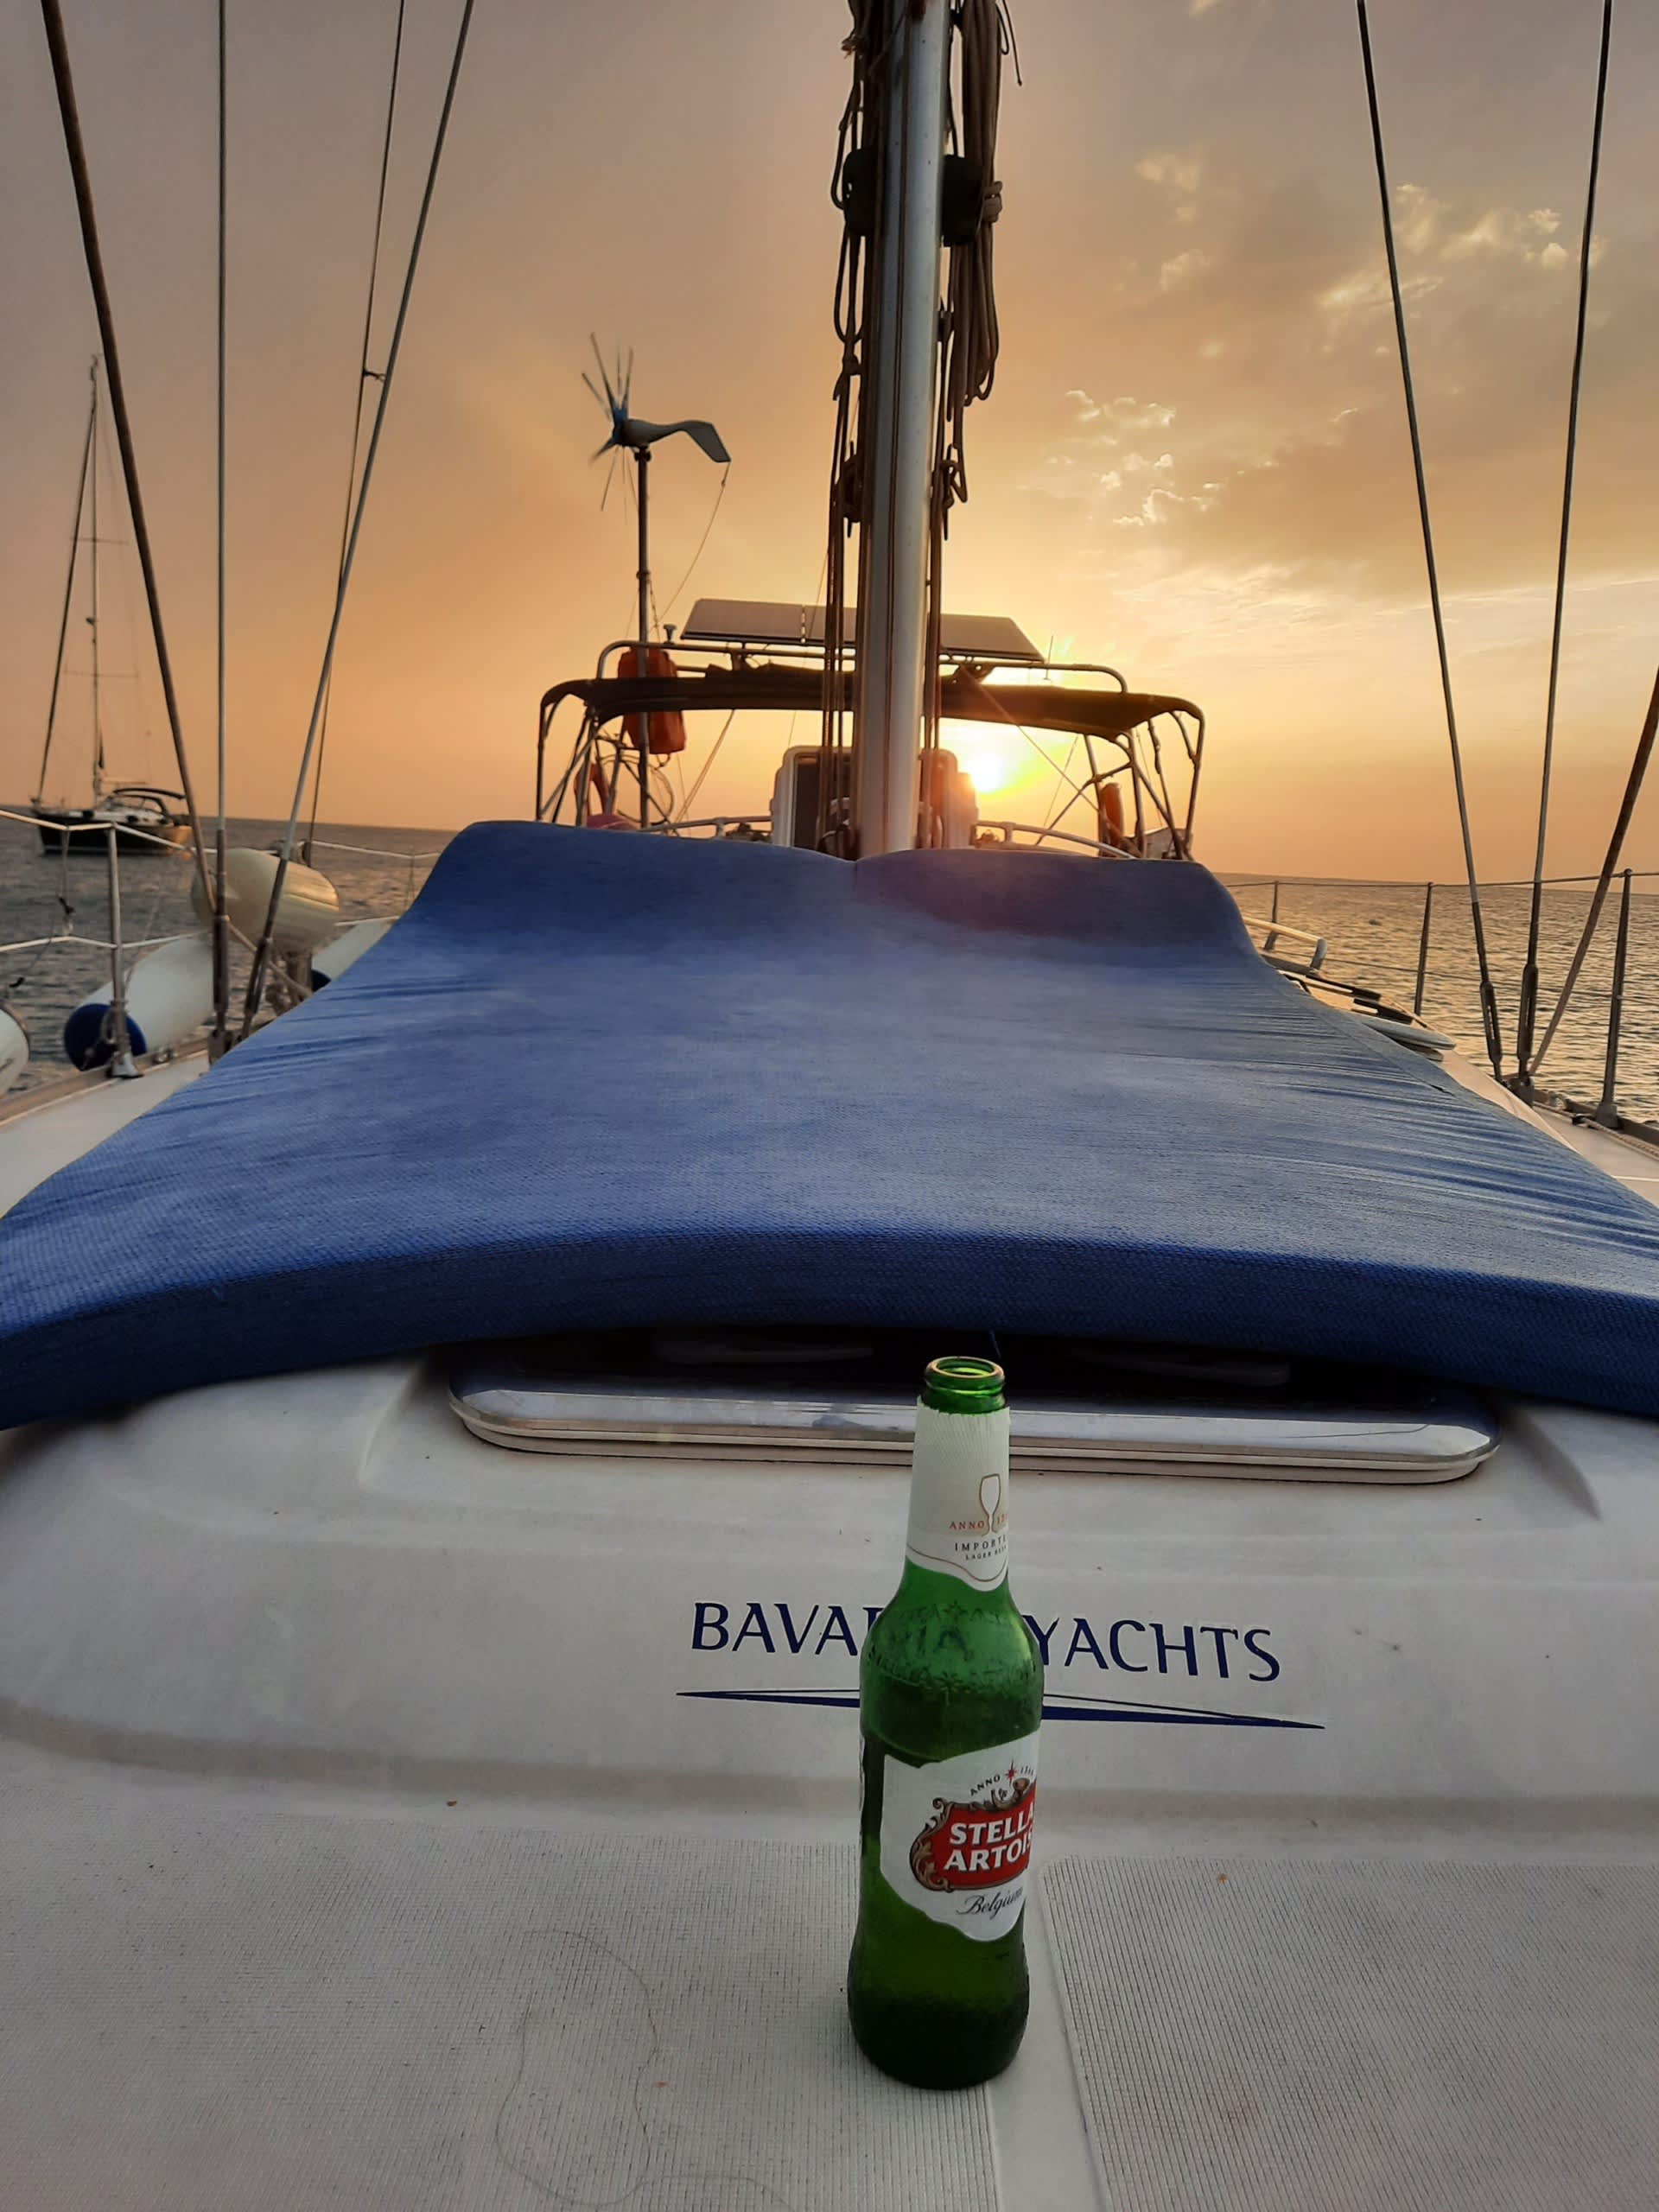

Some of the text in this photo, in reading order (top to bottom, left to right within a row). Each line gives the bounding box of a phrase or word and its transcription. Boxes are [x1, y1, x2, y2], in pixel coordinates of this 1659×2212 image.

[949, 1520, 985, 1530] ANNO
[691, 1602, 885, 1656] BAVA
[1021, 1614, 1281, 1682] YACHTS
[970, 1774, 1001, 1796] ANNO
